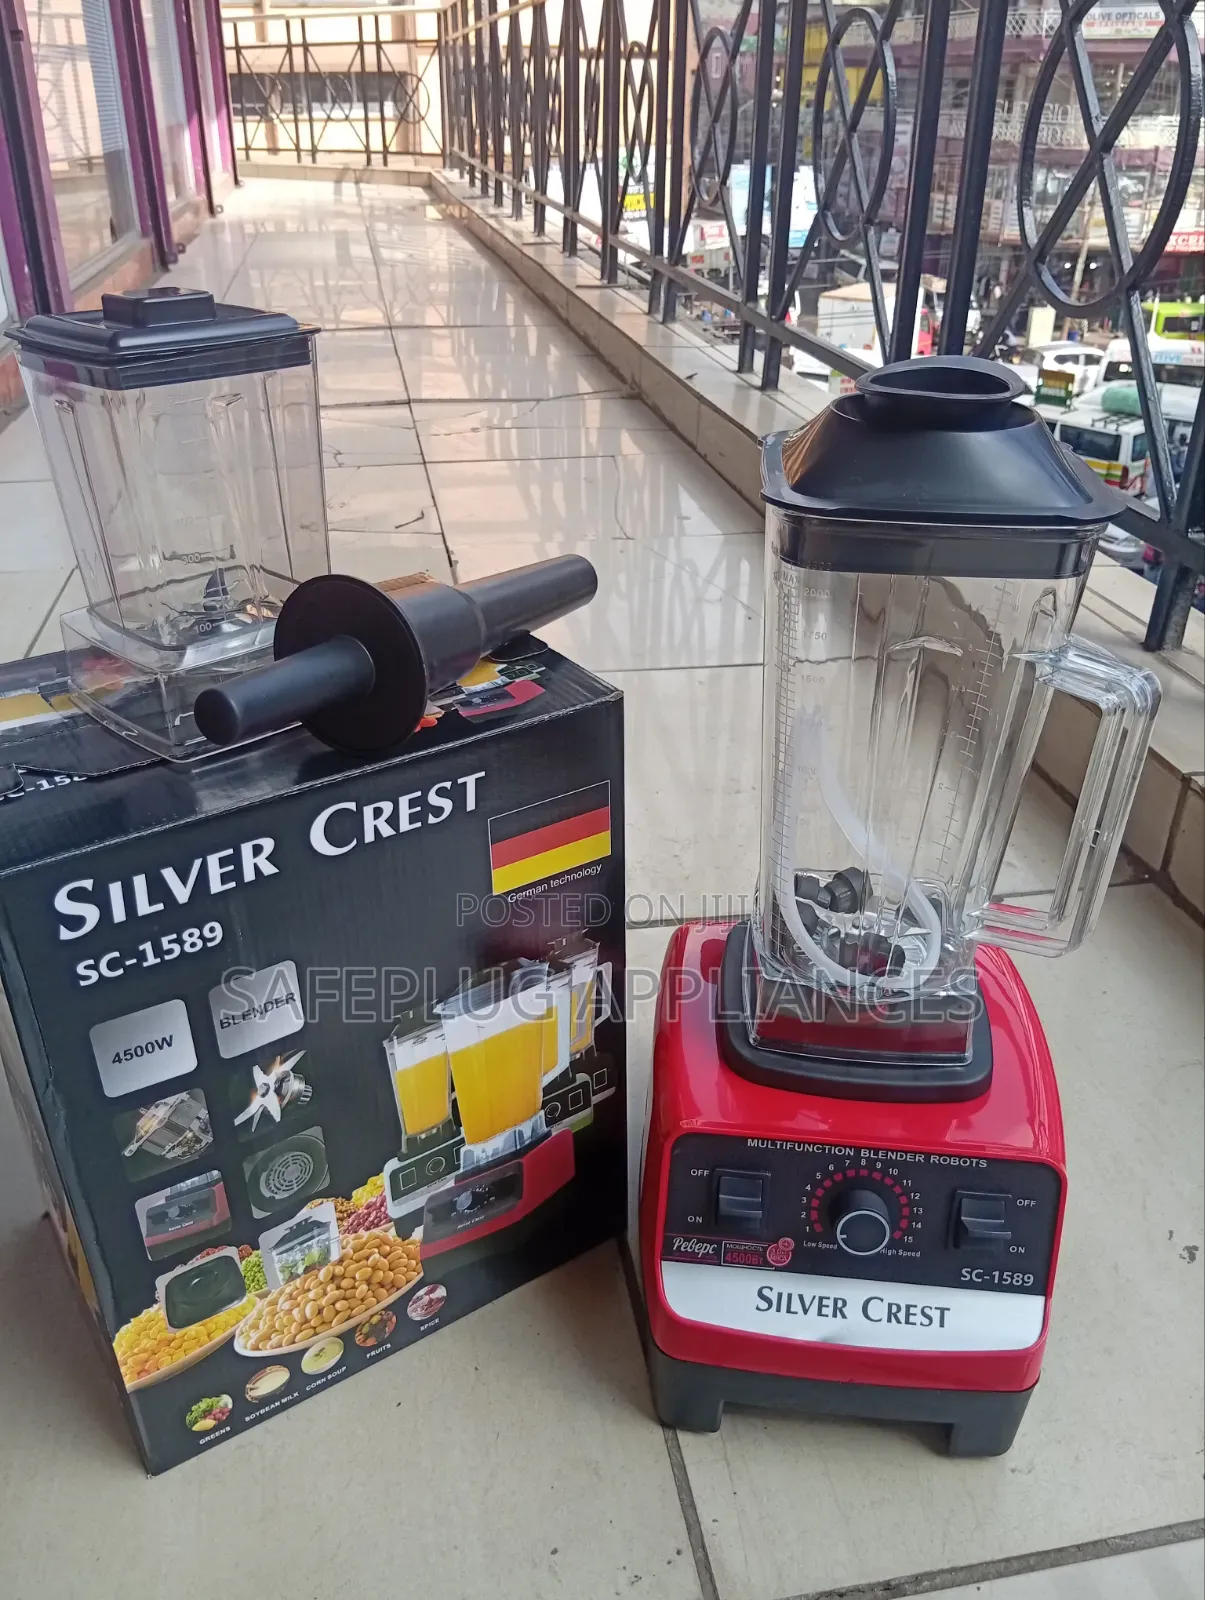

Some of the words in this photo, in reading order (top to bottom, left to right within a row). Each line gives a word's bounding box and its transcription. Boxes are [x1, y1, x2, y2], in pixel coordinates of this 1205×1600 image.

[1115, 12, 1160, 20] OPTICALS
[194, 622, 212, 634] 100
[53, 836, 279, 940] SILVER
[309, 771, 487, 857] CREST
[508, 881, 548, 903] German
[550, 863, 602, 889] technology
[76, 921, 224, 986] SC-1589
[219, 992, 297, 1030] BLENDER
[111, 1034, 174, 1066] 4500W
[747, 1138, 855, 1156] MULTIFUNCTION
[860, 1148, 925, 1163] BLENDER
[930, 1155, 988, 1168] ROBOTS
[875, 1161, 882, 1169] 9
[690, 1169, 710, 1177] OFF
[816, 1172, 822, 1180] 5
[902, 1179, 912, 1187] 11
[910, 1192, 920, 1200] 12
[1016, 1199, 1037, 1207] OFF
[687, 1215, 703, 1223] ON
[672, 1236, 718, 1258] Реверс
[818, 1242, 838, 1250] Speed
[897, 1249, 921, 1258] Speed
[1009, 1246, 1026, 1254] ON
[960, 1267, 1034, 1287] SC-1589
[755, 1285, 848, 1320] SILVER
[861, 1295, 951, 1329] CREST
[420, 1317, 440, 1331] SPICE
[366, 1342, 391, 1358] FRUITS
[305, 1377, 327, 1391] CORN
[327, 1366, 347, 1381] SOUP
[244, 1401, 281, 1422] SOYBEAN
[281, 1391, 299, 1405] MILK
[199, 1425, 231, 1445] GREENS
